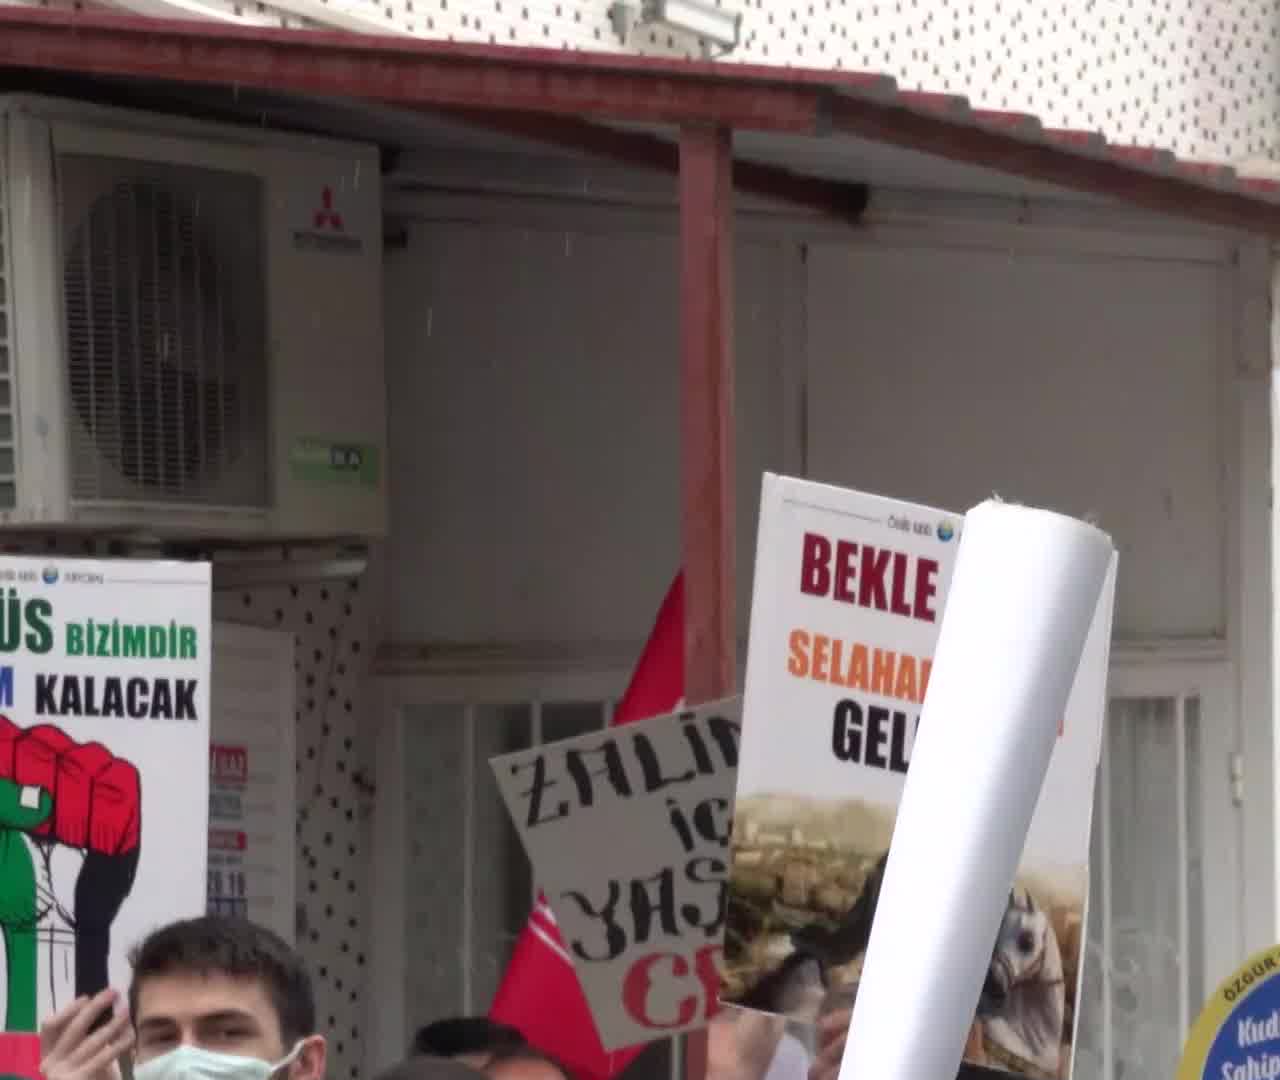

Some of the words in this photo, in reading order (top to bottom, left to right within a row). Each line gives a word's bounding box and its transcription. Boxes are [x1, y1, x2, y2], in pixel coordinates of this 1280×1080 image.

[800, 532, 939, 622] BEKLE
[66, 617, 198, 660] BİZİMDİR
[35, 673, 198, 720] KALACAK
[831, 697, 920, 774] GEL
